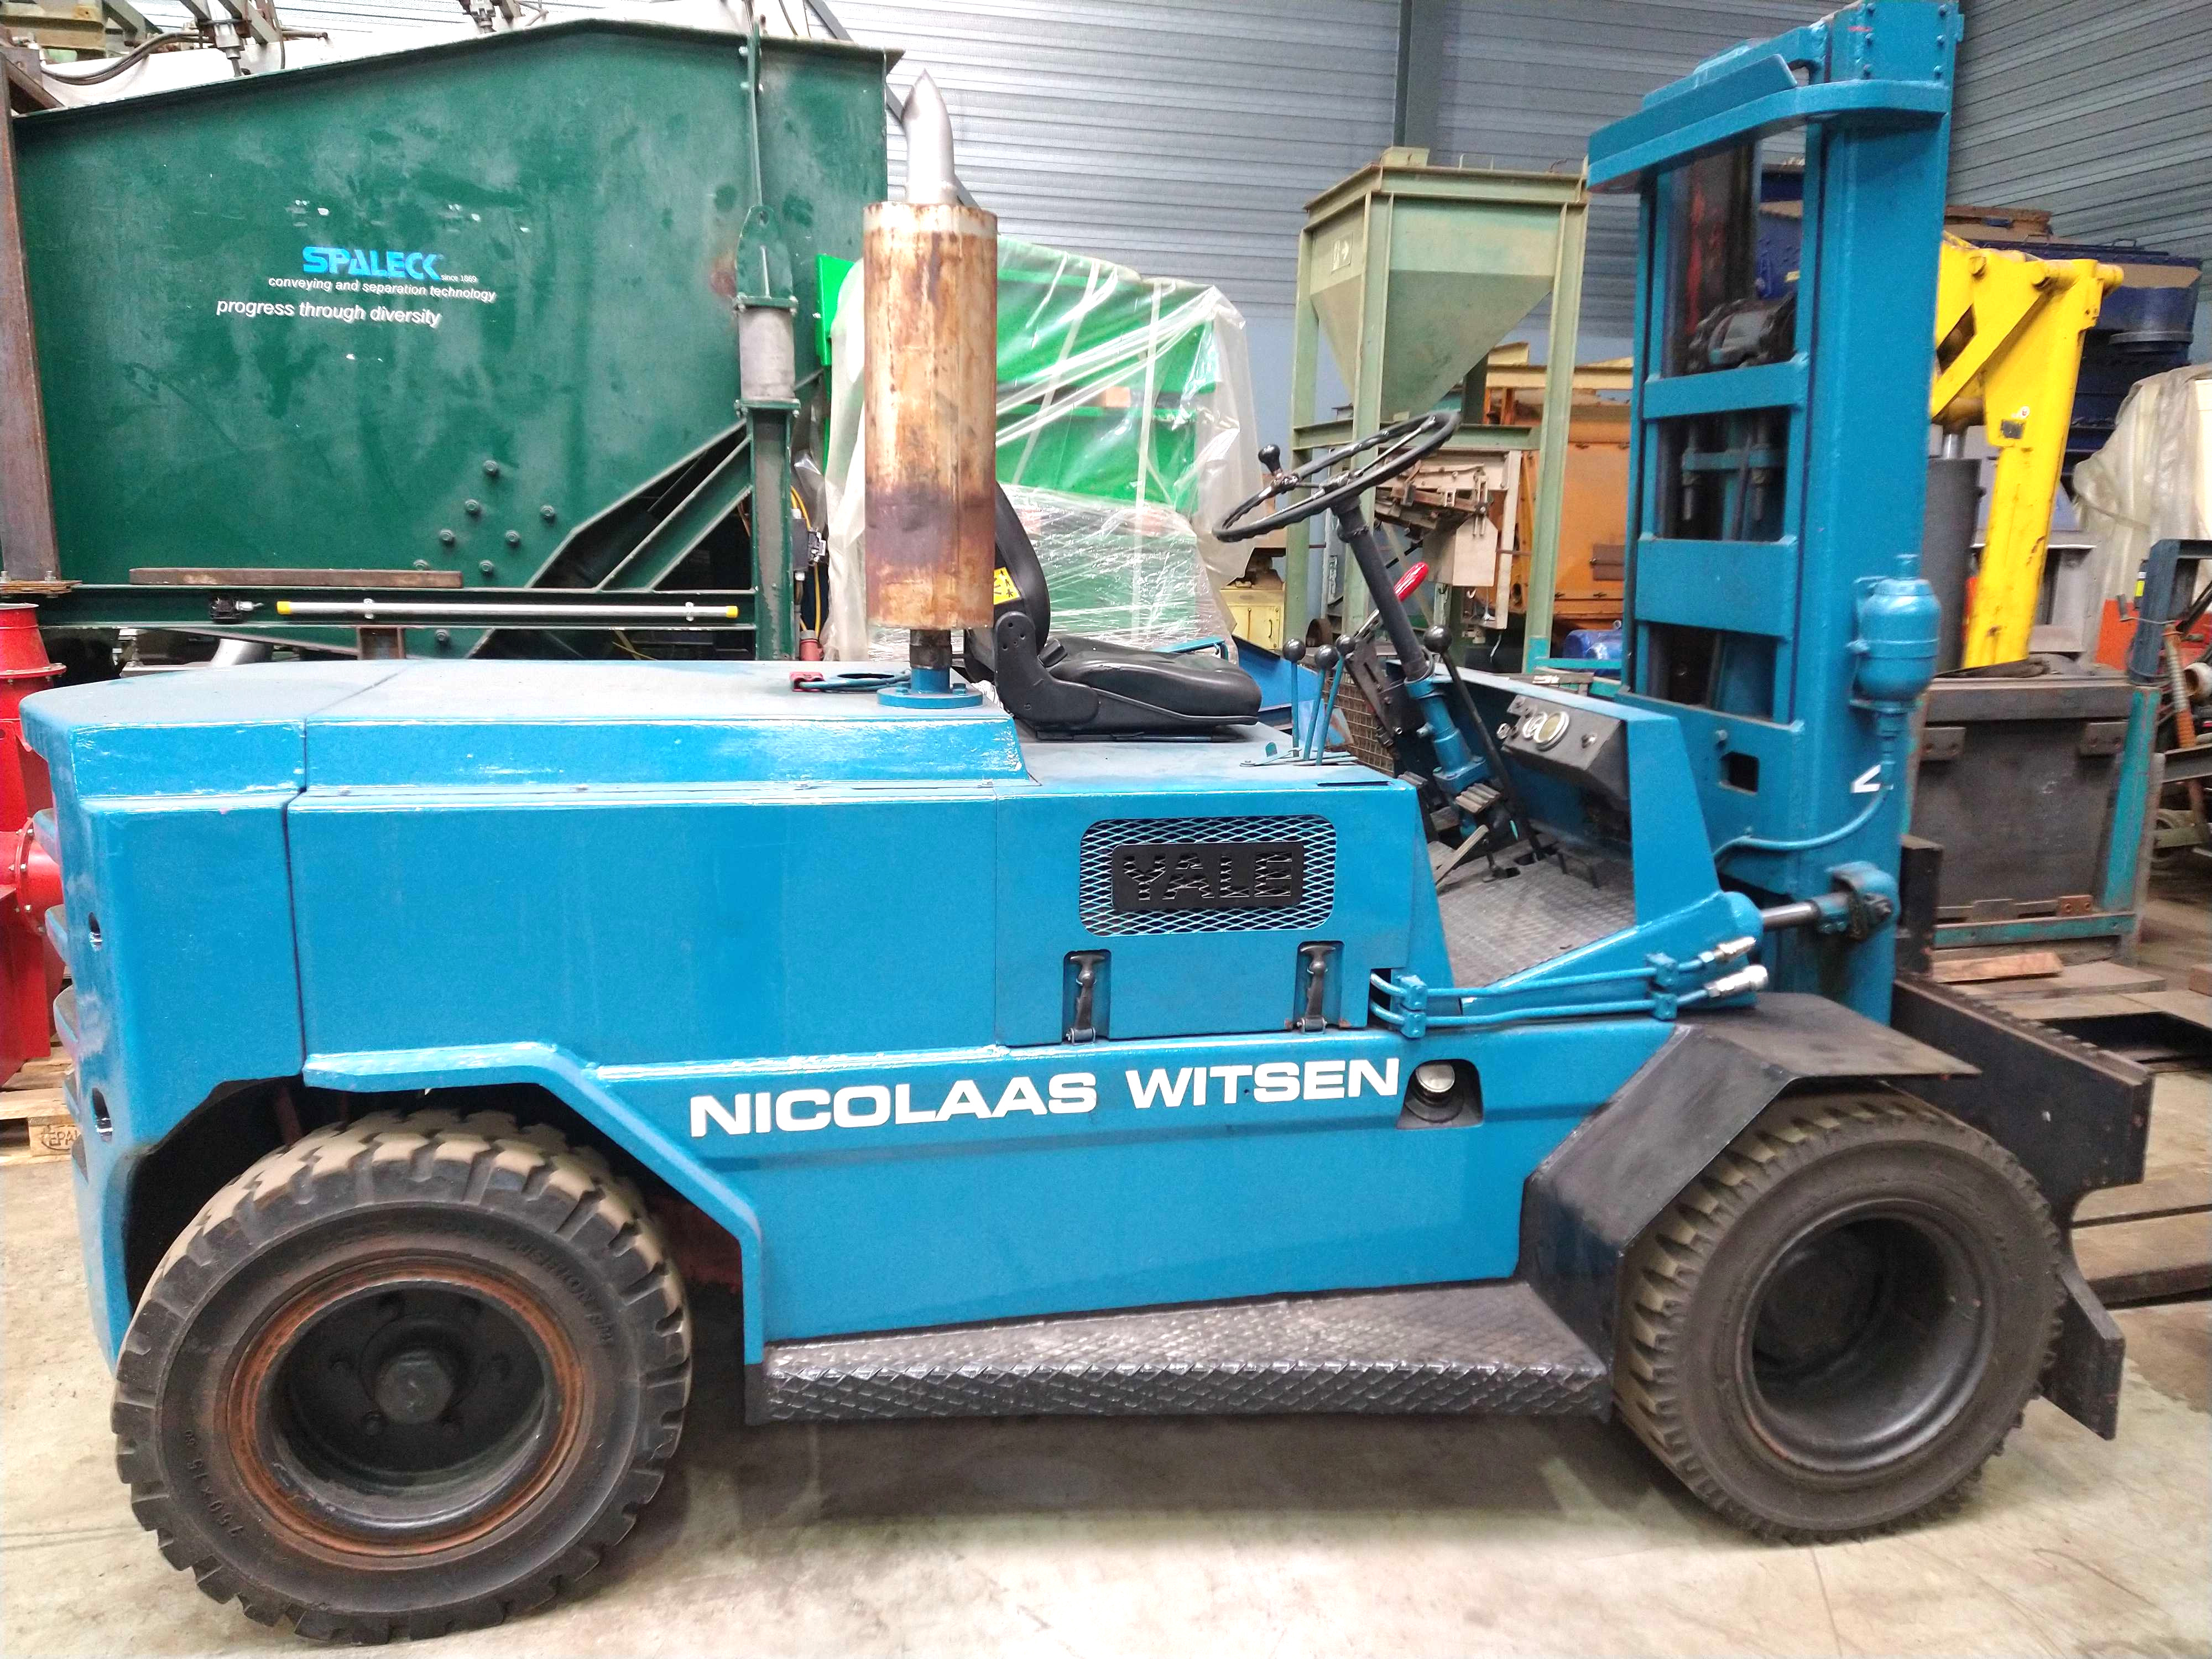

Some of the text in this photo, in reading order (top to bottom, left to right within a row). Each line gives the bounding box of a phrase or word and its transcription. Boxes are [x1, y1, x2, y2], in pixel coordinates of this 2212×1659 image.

[302, 246, 441, 280] SPALECK
[268, 277, 497, 304] conveying and separation technology
[441, 274, 478, 284] since 1869
[216, 300, 442, 329] progress through diversity
[1123, 852, 1293, 901] YALE
[690, 1057, 1400, 1138] NICOLAAS WITSEN
